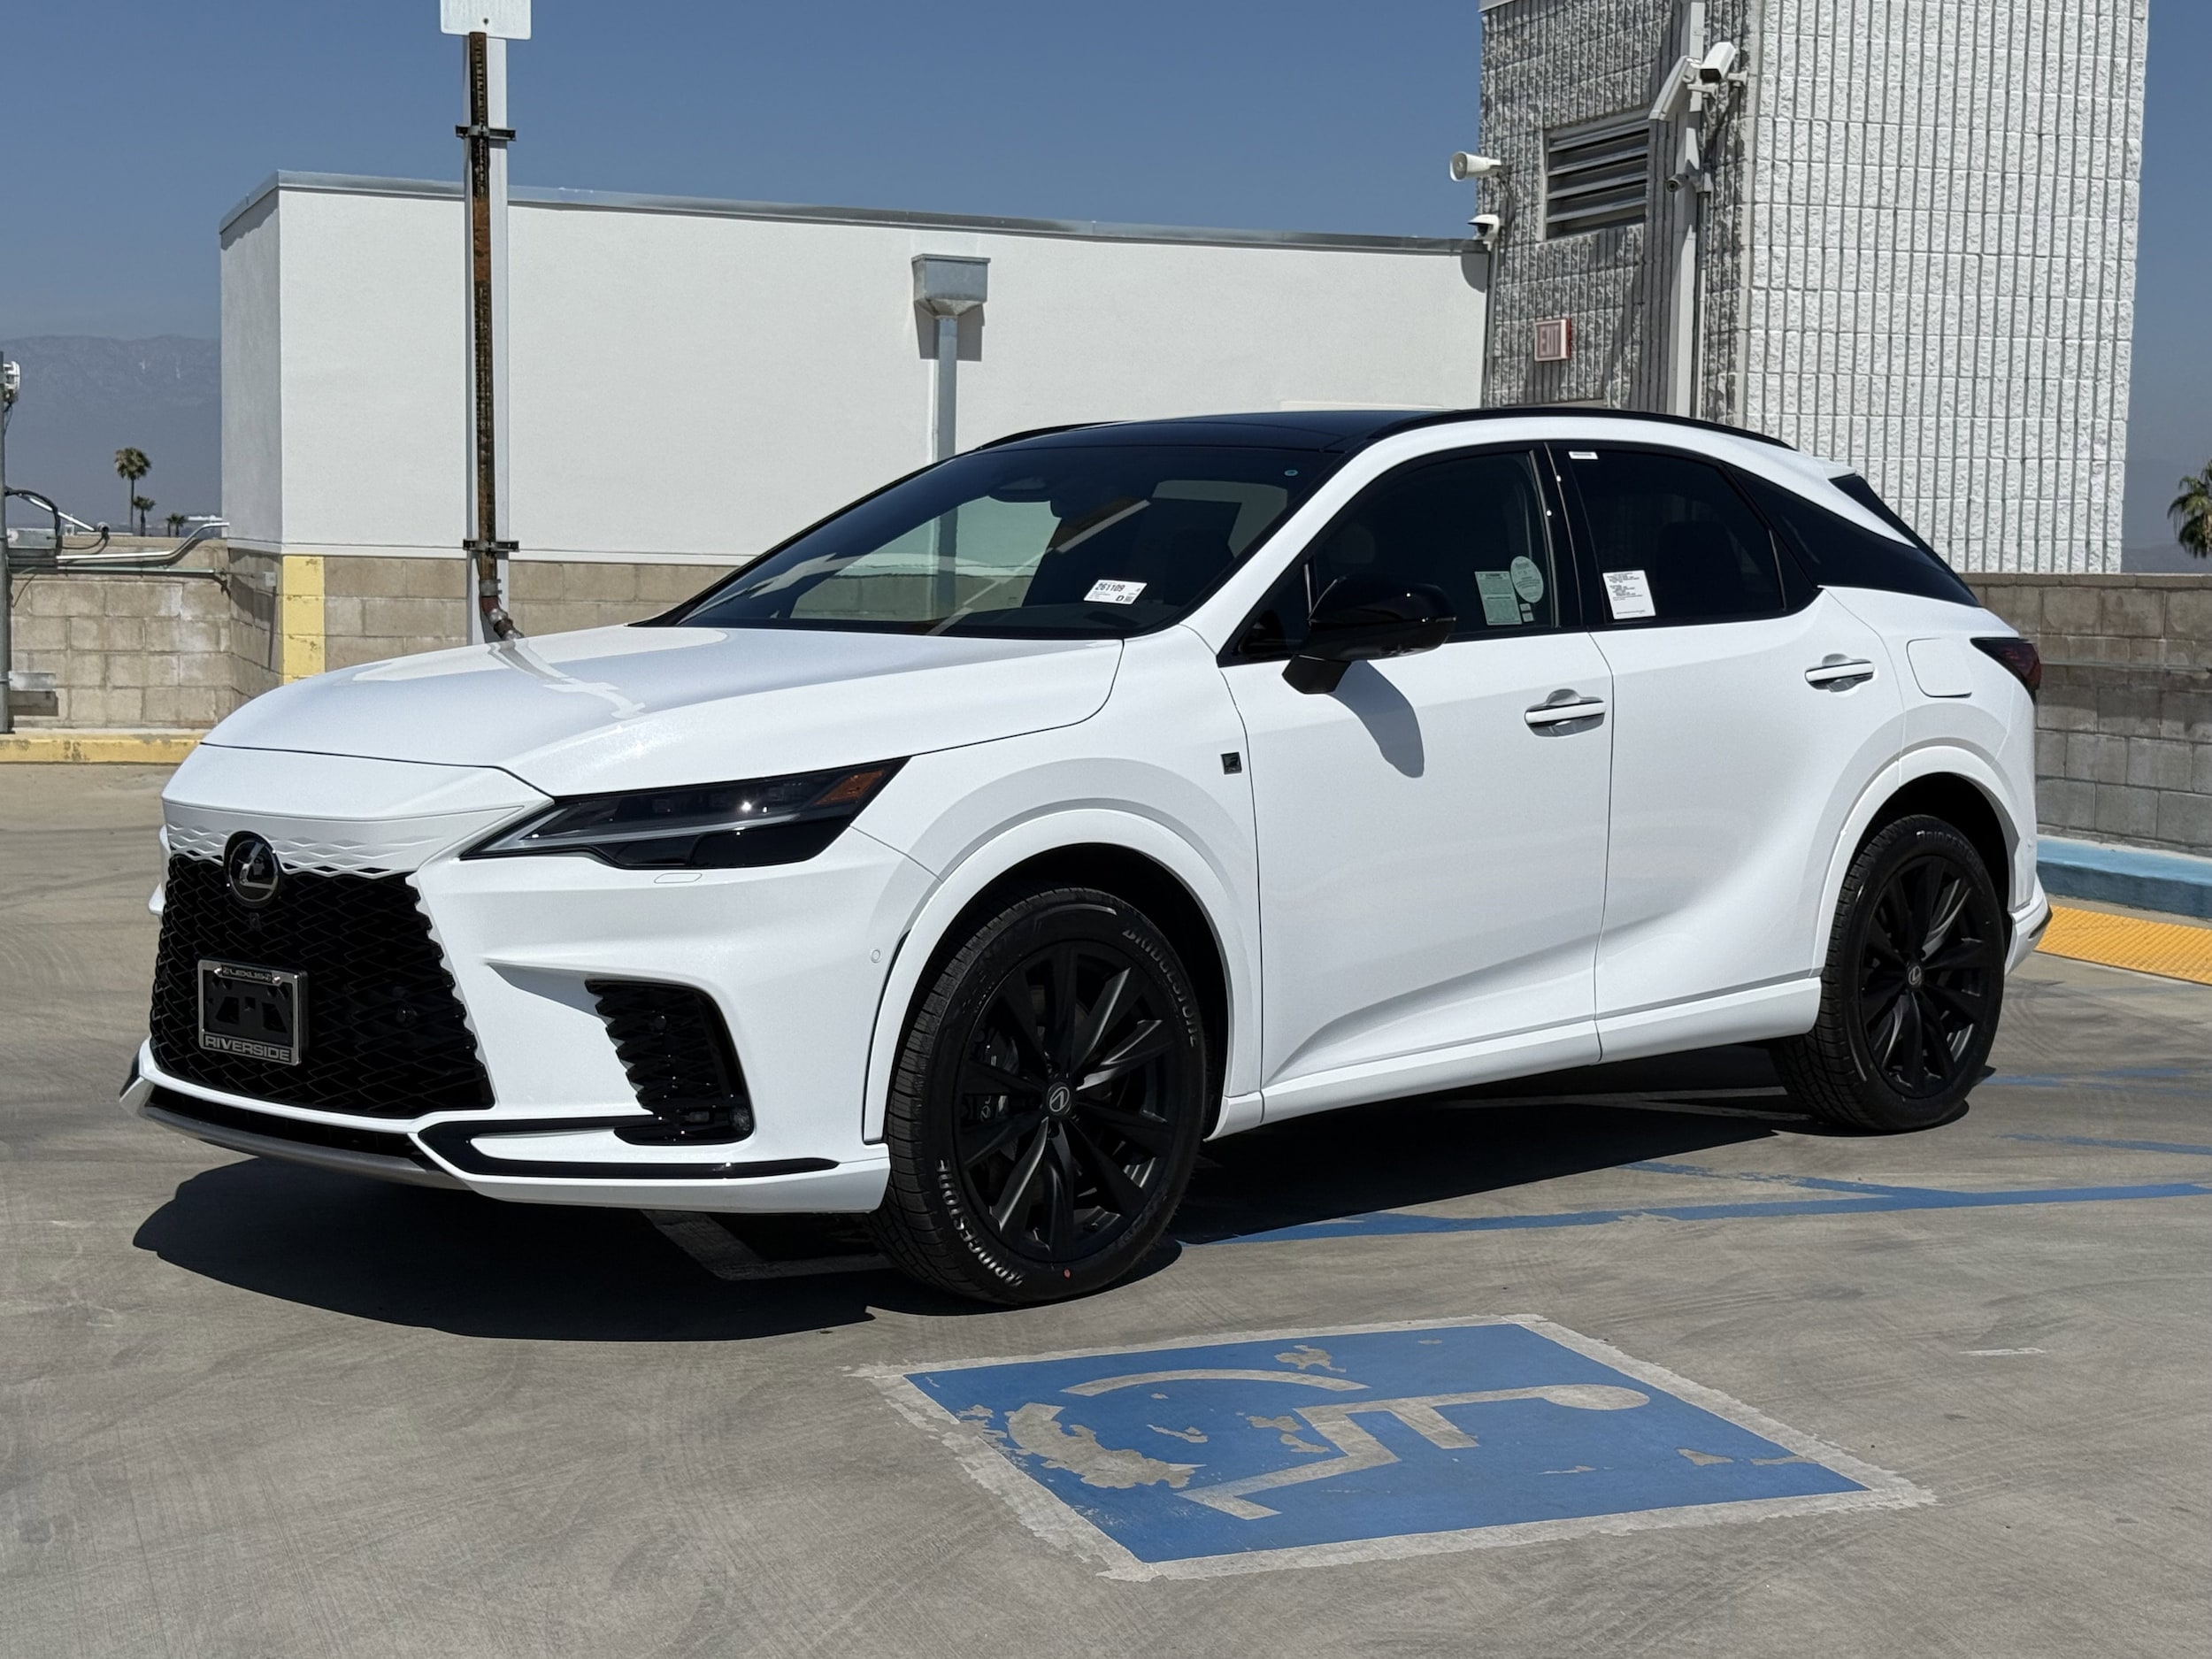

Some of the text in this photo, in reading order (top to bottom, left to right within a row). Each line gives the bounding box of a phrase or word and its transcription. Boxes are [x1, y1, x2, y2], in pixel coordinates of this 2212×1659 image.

[1540, 326, 1559, 356] EXIT
[229, 968, 265, 980] LEXUS
[204, 1035, 290, 1061] RIVERSIDE
[935, 1157, 1025, 1288] BRIDGESTONE
